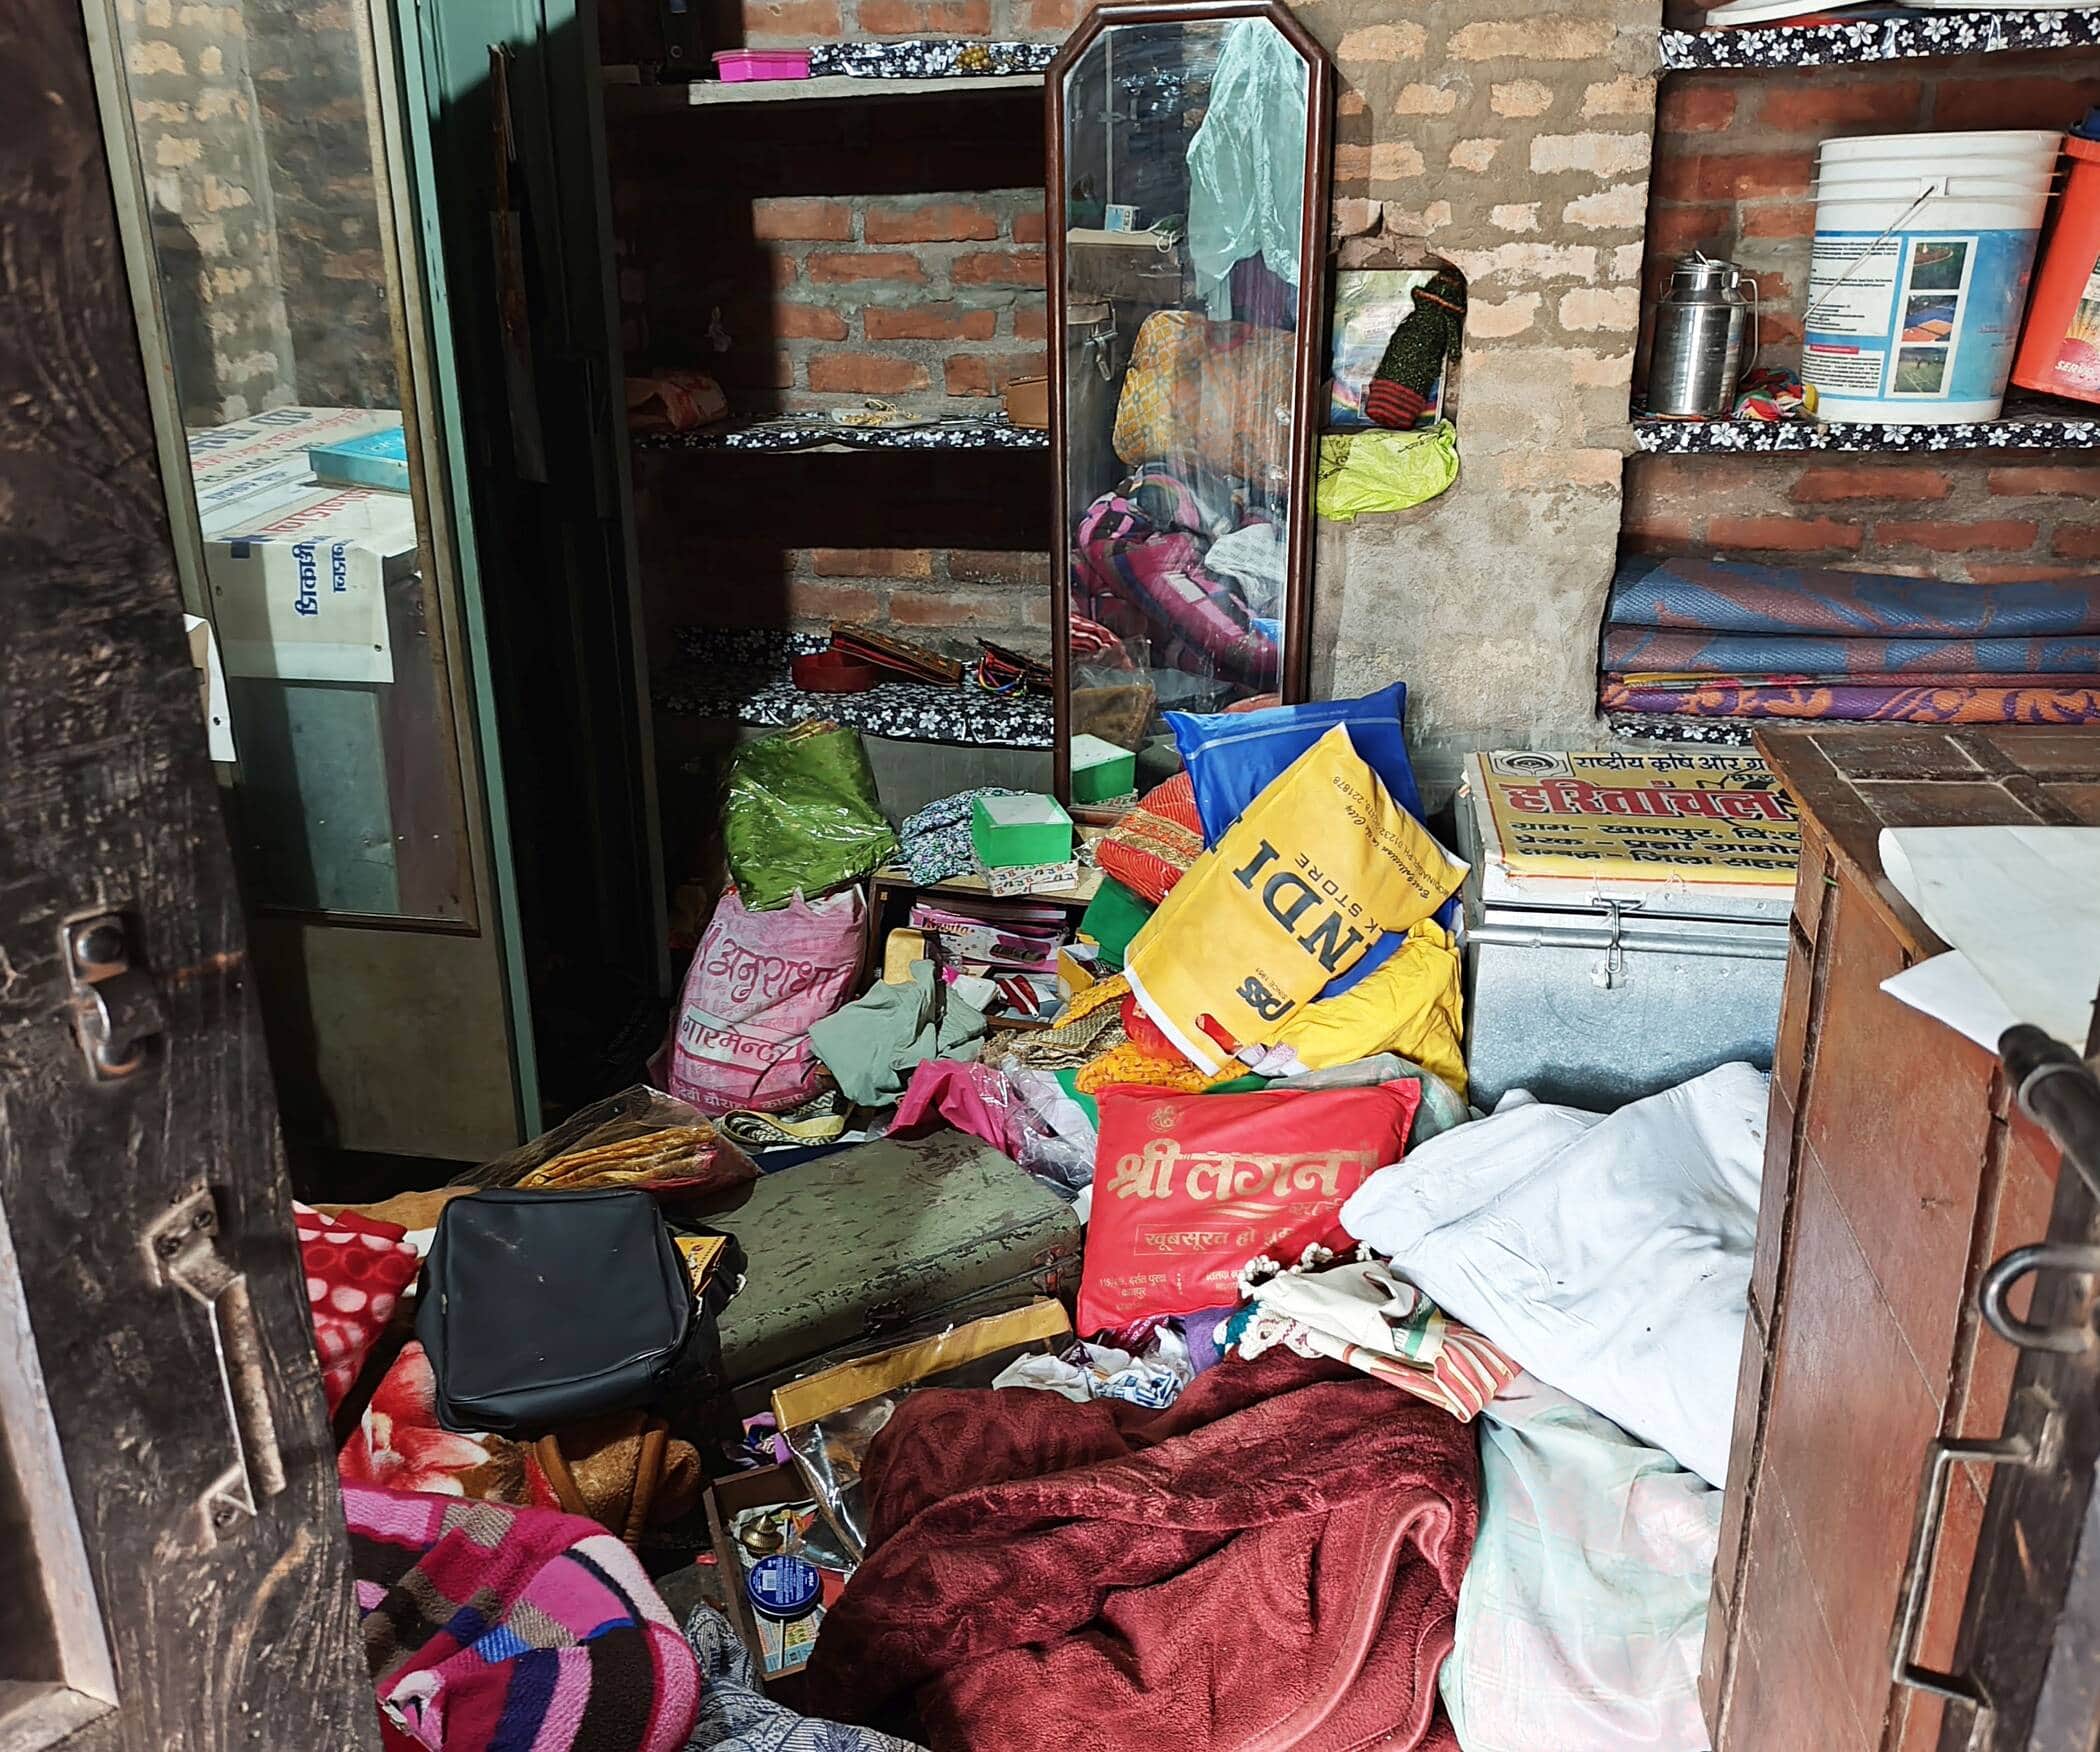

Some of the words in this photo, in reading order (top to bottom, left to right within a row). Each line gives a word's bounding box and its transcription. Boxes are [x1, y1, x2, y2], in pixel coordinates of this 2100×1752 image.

[1573, 752, 1645, 771] राष्ट्रीय
[1648, 753, 1695, 773] कृषि
[1699, 754, 1740, 771] और
[1233, 839, 1373, 974] NDI
[1294, 852, 1363, 918] STORE
[1144, 1231, 1229, 1251] खूबसूरत
